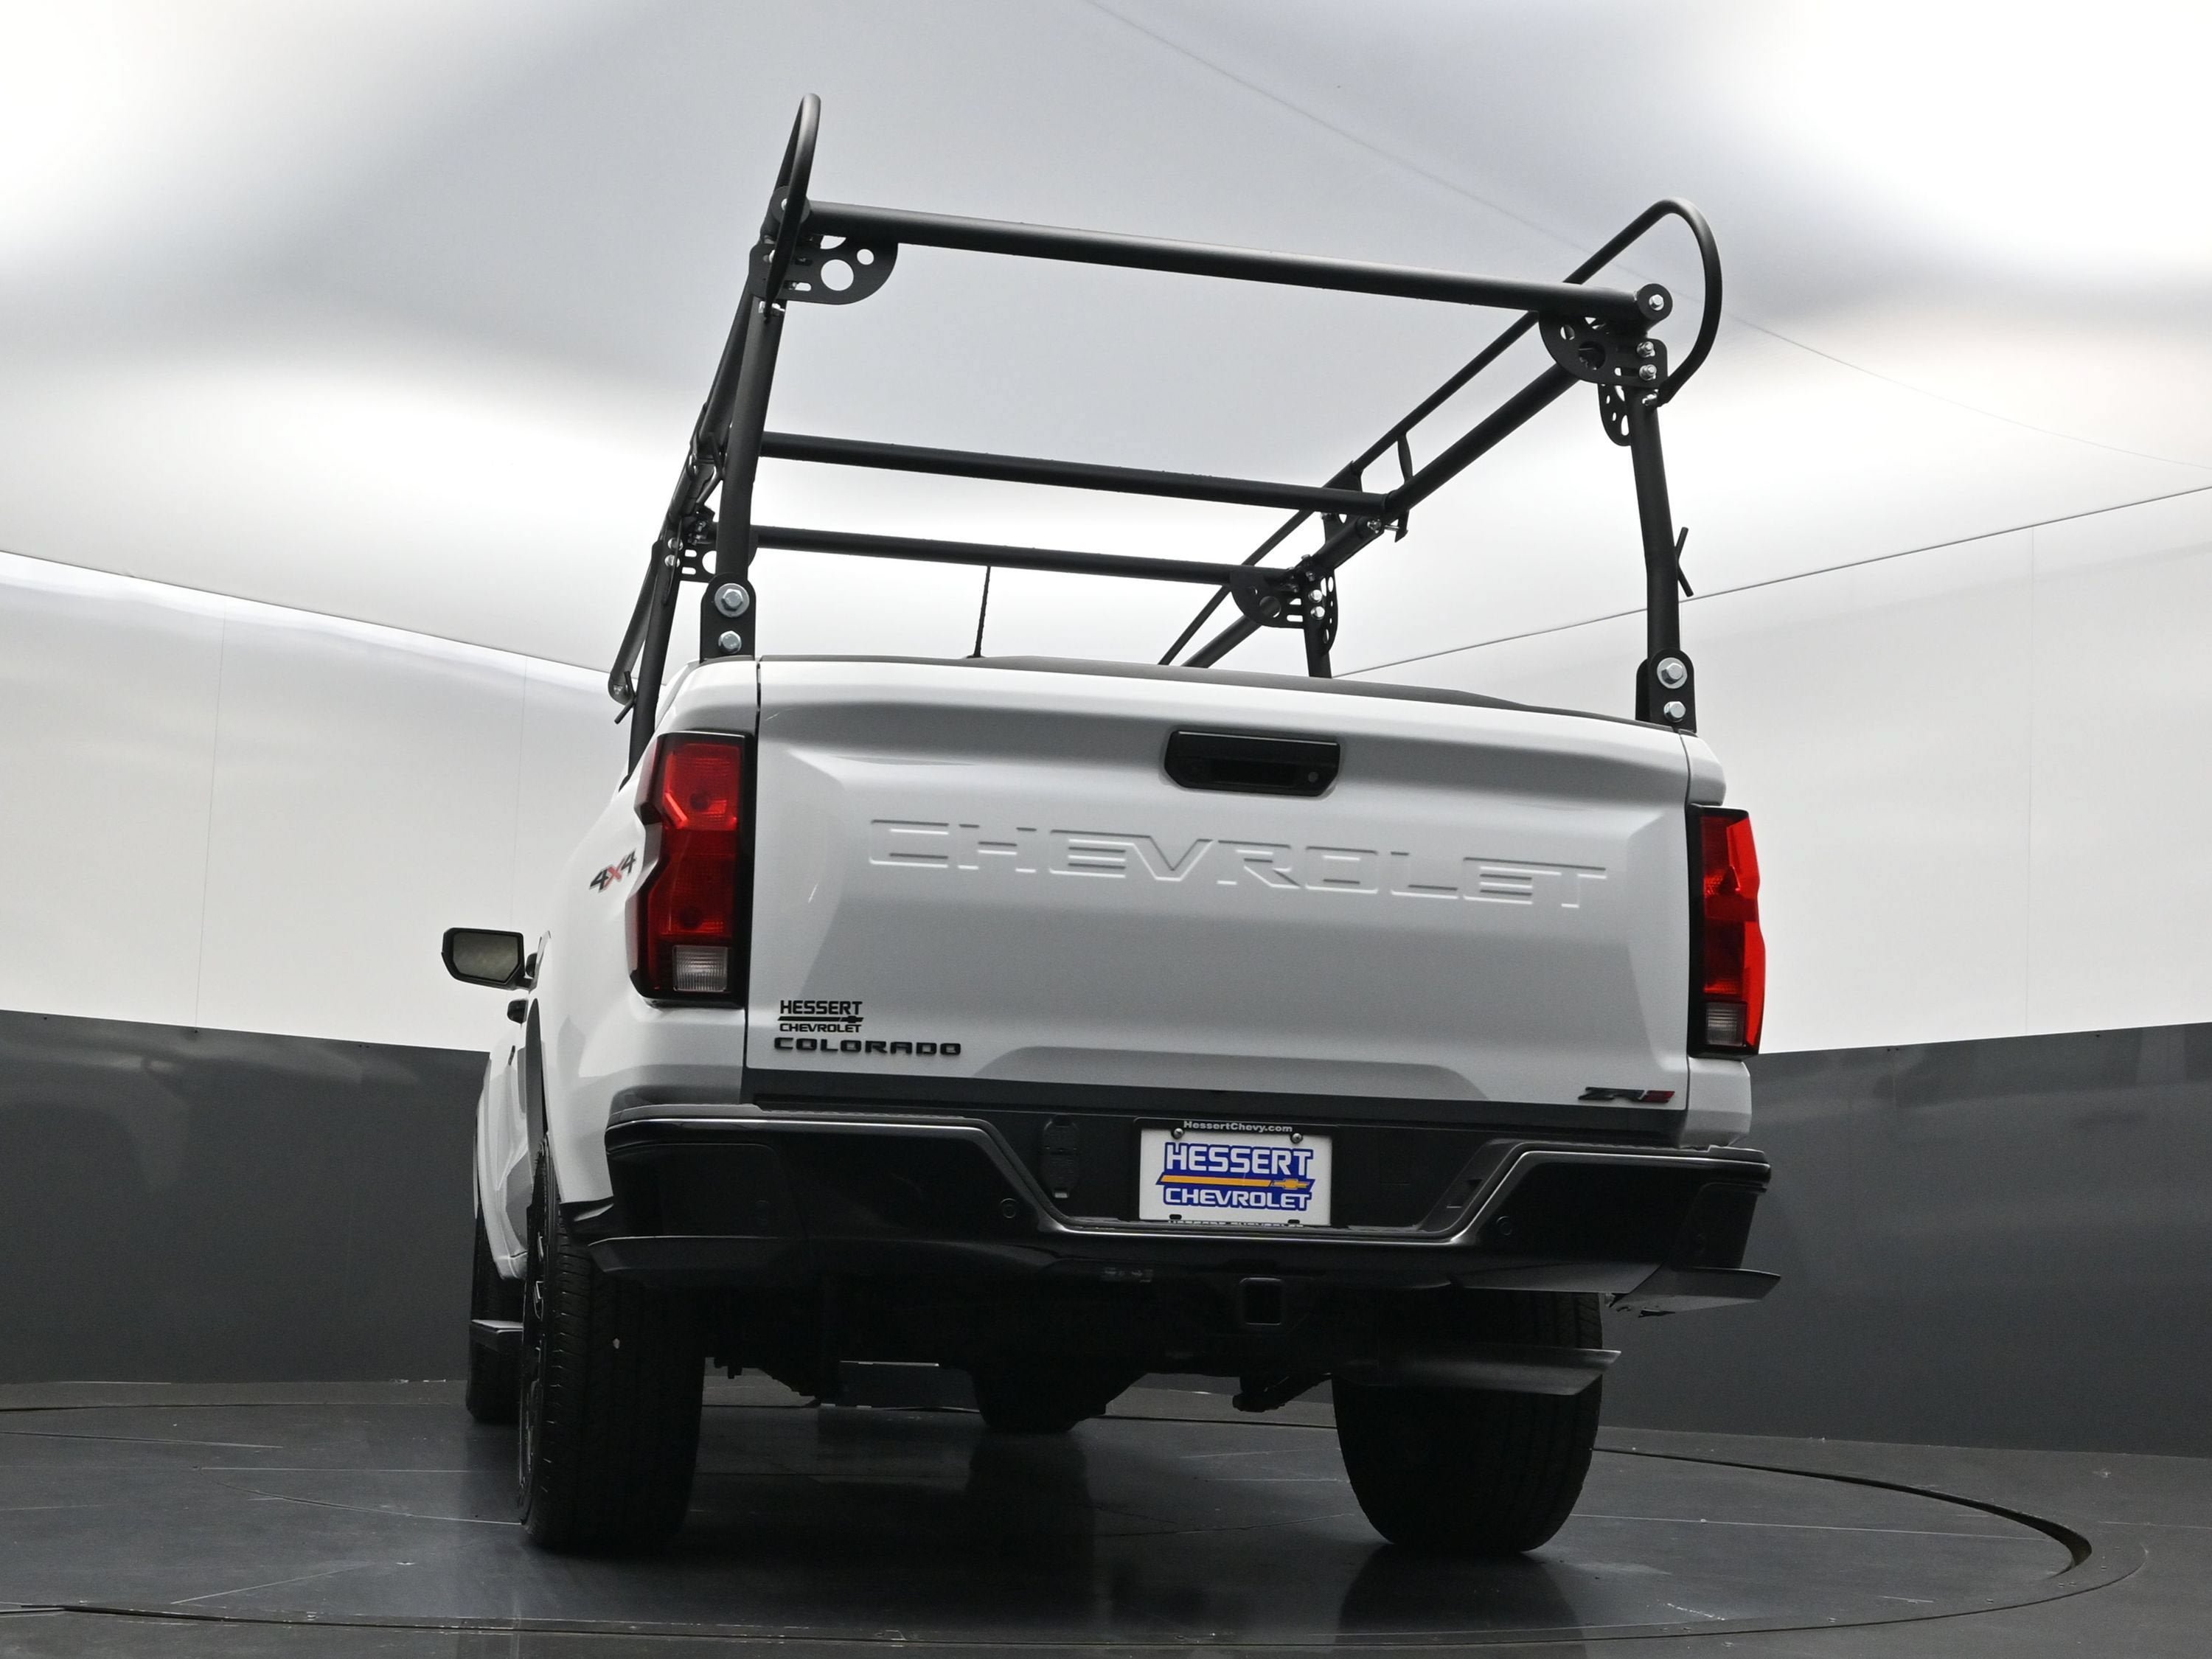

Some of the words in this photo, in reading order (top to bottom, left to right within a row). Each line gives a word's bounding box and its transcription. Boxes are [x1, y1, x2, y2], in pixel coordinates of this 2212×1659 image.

[870, 820, 1607, 908] CHEVROLET
[780, 1000, 863, 1015] HESSERT
[779, 1023, 862, 1033] CHEVROLET
[774, 1037, 961, 1056] COLORADO
[1183, 1120, 1293, 1133] HessertChevy.com
[1165, 1143, 1313, 1177] HESSERT
[1164, 1187, 1312, 1210] CHEVROLET
